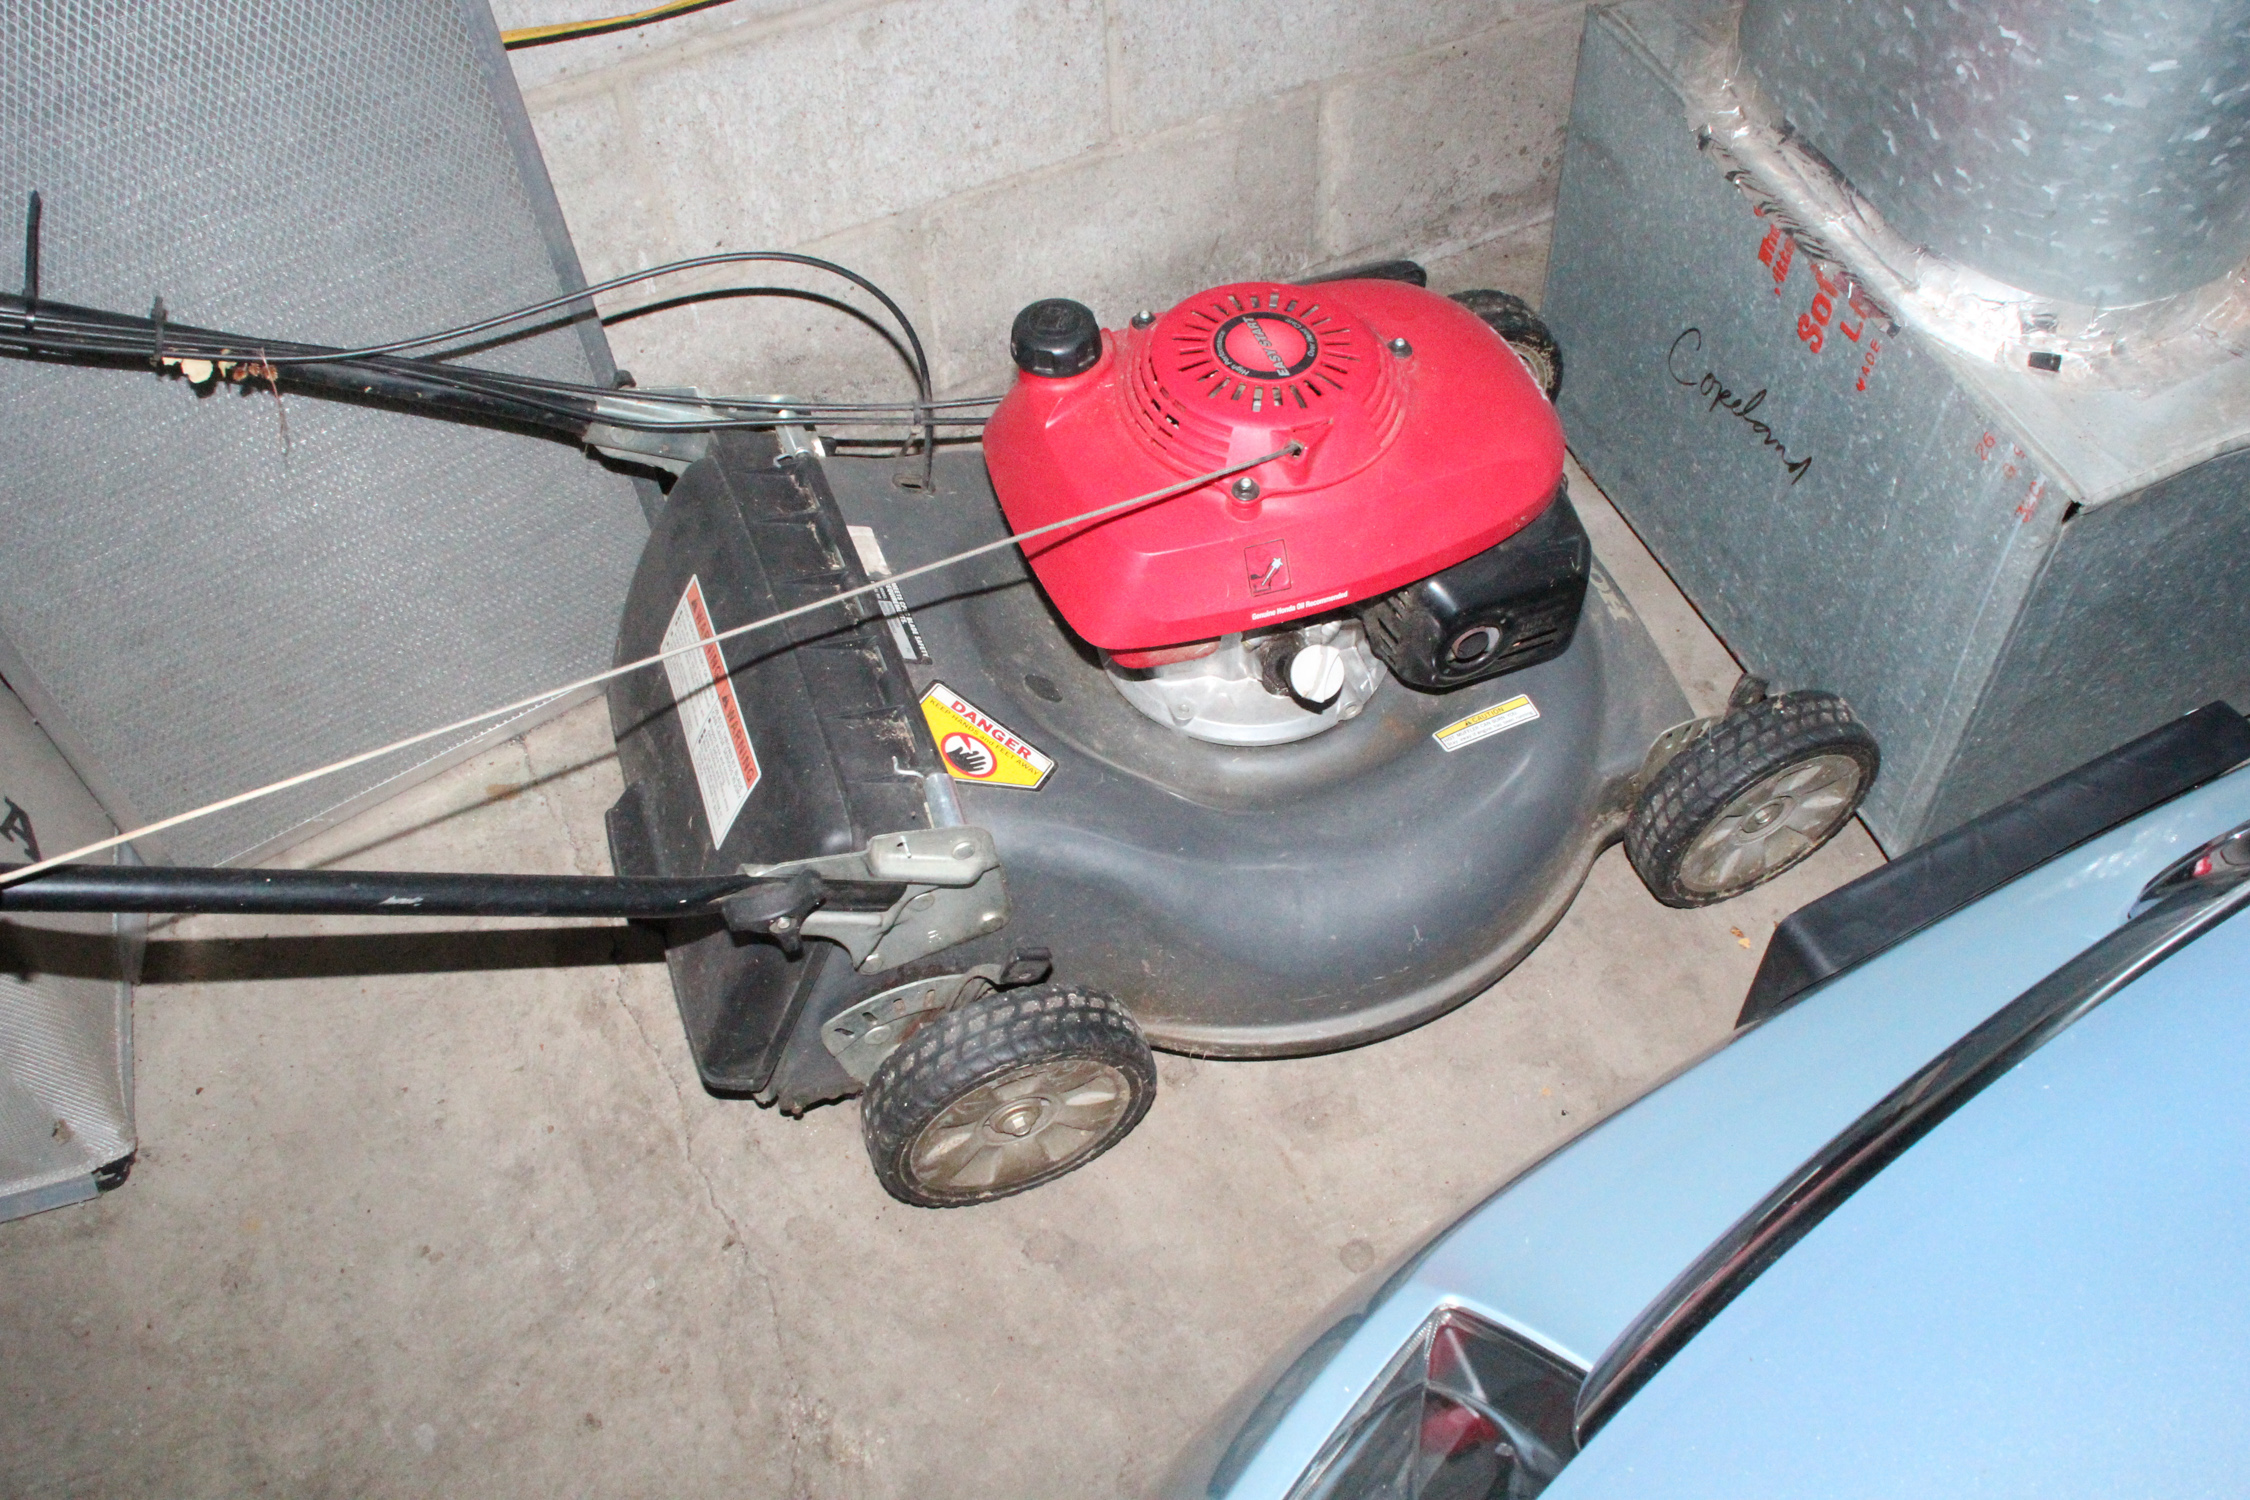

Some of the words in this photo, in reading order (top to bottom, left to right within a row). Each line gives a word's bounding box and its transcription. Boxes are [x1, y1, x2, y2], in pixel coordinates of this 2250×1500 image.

[1242, 317, 1272, 347] START
[1264, 348, 1291, 376] EASY
[1668, 327, 1812, 485] Copeland
[1975, 432, 1996, 460] 26
[1252, 610, 1276, 621] Genuine
[1277, 604, 1296, 615] Honda
[1296, 602, 1305, 610] Oil
[1305, 590, 1349, 608] Recommended
[914, 635, 930, 658] SAFETY
[951, 700, 1032, 760] DANGER
[1471, 707, 1505, 724] CAUTION
[727, 709, 755, 782] WARNING
[930, 699, 951, 715] KEEP
[952, 714, 979, 737] HANDS
[980, 735, 994, 746] and
[995, 744, 1015, 760] FEET
[1016, 757, 1039, 776] AWAY
